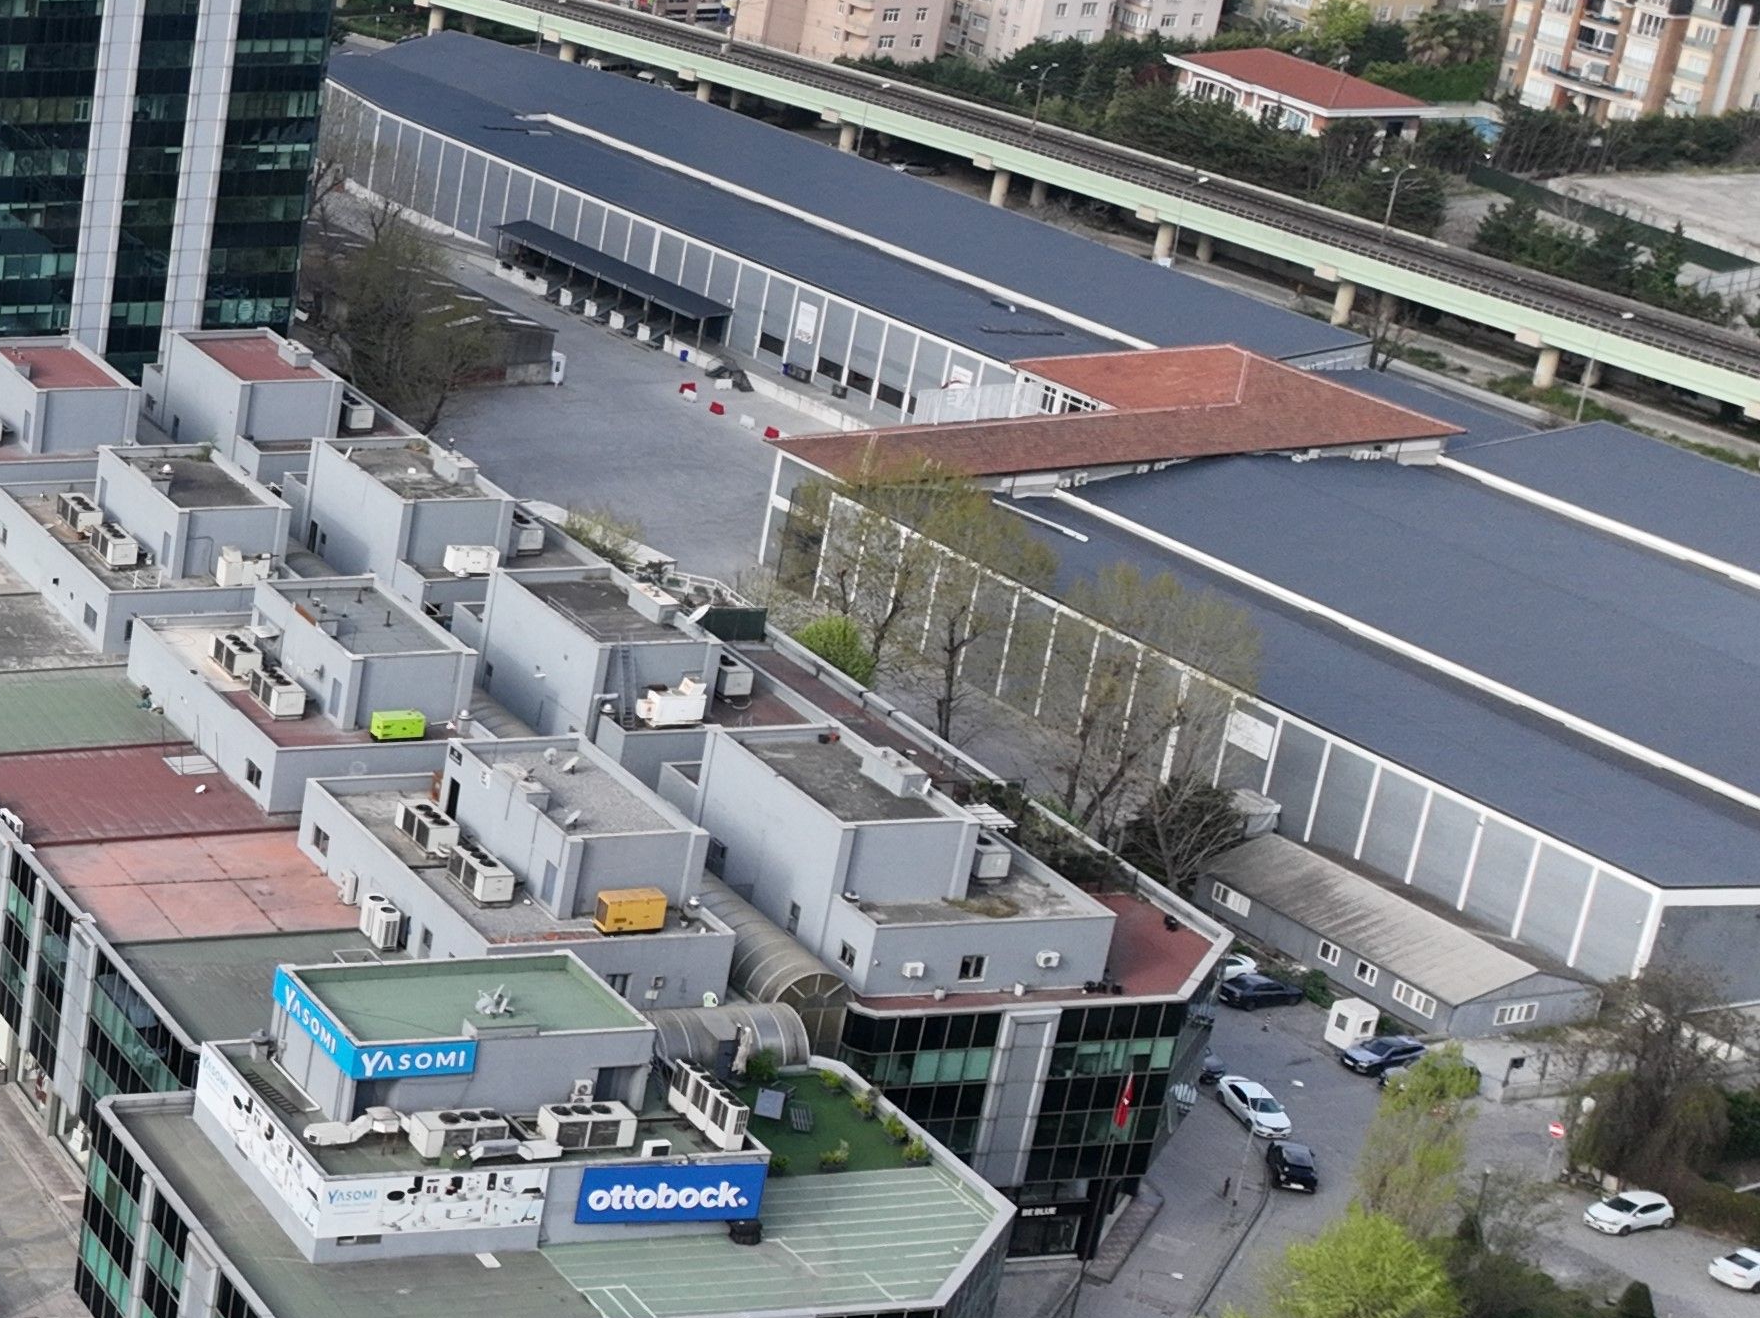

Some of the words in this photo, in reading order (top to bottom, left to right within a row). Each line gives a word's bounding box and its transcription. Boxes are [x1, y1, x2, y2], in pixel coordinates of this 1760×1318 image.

[284, 984, 337, 1055] YASOMI
[361, 1049, 466, 1078] YASOMI
[327, 1188, 379, 1205] YASOMI
[587, 1181, 749, 1212] ottobock.
